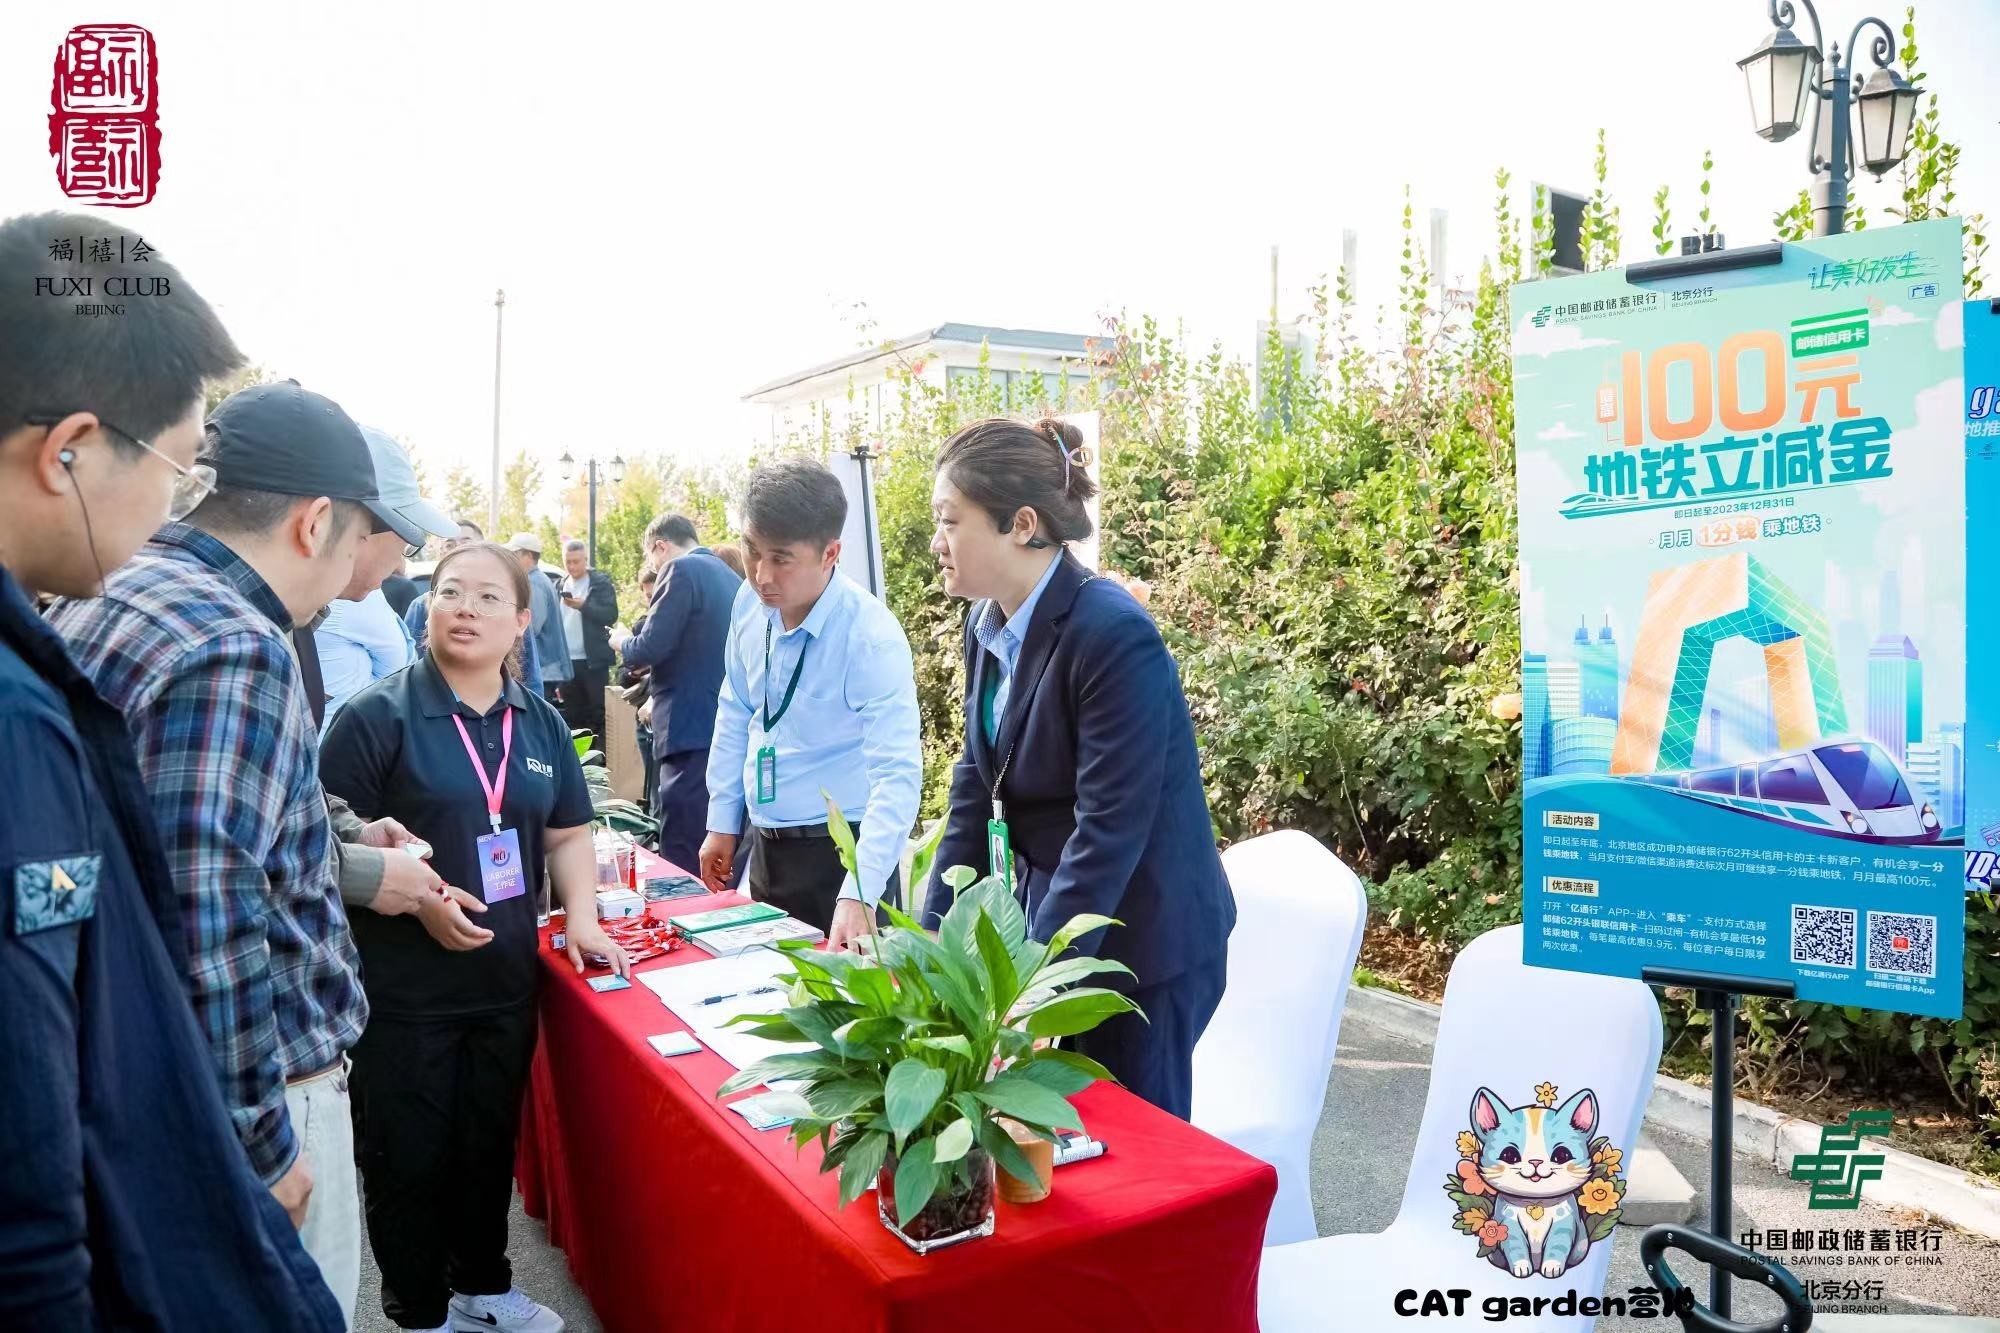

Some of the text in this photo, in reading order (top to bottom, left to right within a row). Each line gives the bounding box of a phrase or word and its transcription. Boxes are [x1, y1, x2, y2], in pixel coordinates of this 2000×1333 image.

[1808, 251, 1926, 291] 让美好发生
[1671, 286, 1714, 302] 北京分行
[1911, 285, 1936, 298] 广告
[1555, 292, 1657, 317] 中国邮政储蓄银行
[1796, 328, 1866, 351] 邮储信用卡
[1583, 416, 1893, 501] 地铁立减金
[1674, 497, 1795, 519] 即日起至2023年12月31日
[1552, 814, 1595, 827] 活动内容
[1551, 880, 1594, 894] 优惠流程
